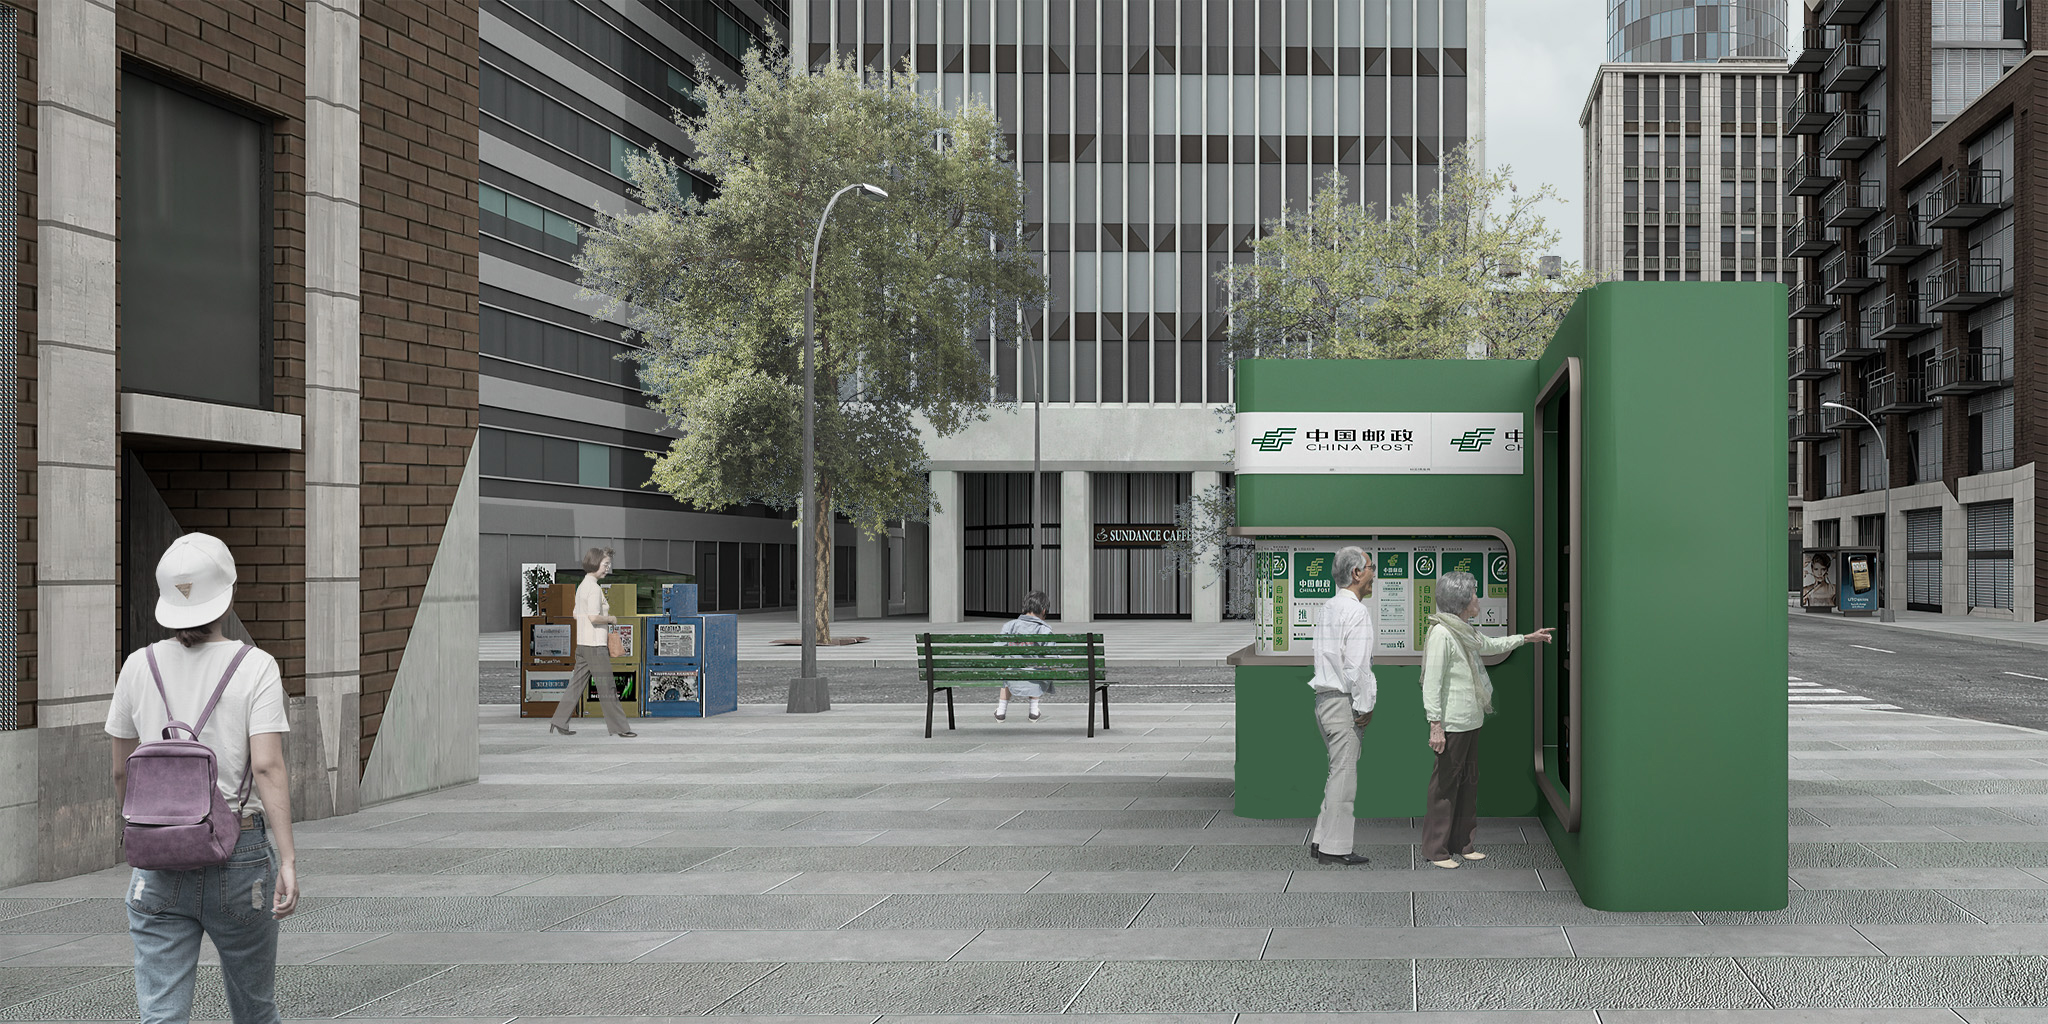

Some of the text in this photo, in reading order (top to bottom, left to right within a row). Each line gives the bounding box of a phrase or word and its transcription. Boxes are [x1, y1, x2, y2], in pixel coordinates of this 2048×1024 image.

[1306, 428, 1414, 443] 中国邮政
[1306, 443, 1414, 452] CHINA POST
[1110, 529, 1161, 542] SUNDANCE
[1299, 579, 1331, 588] 中国邮政
